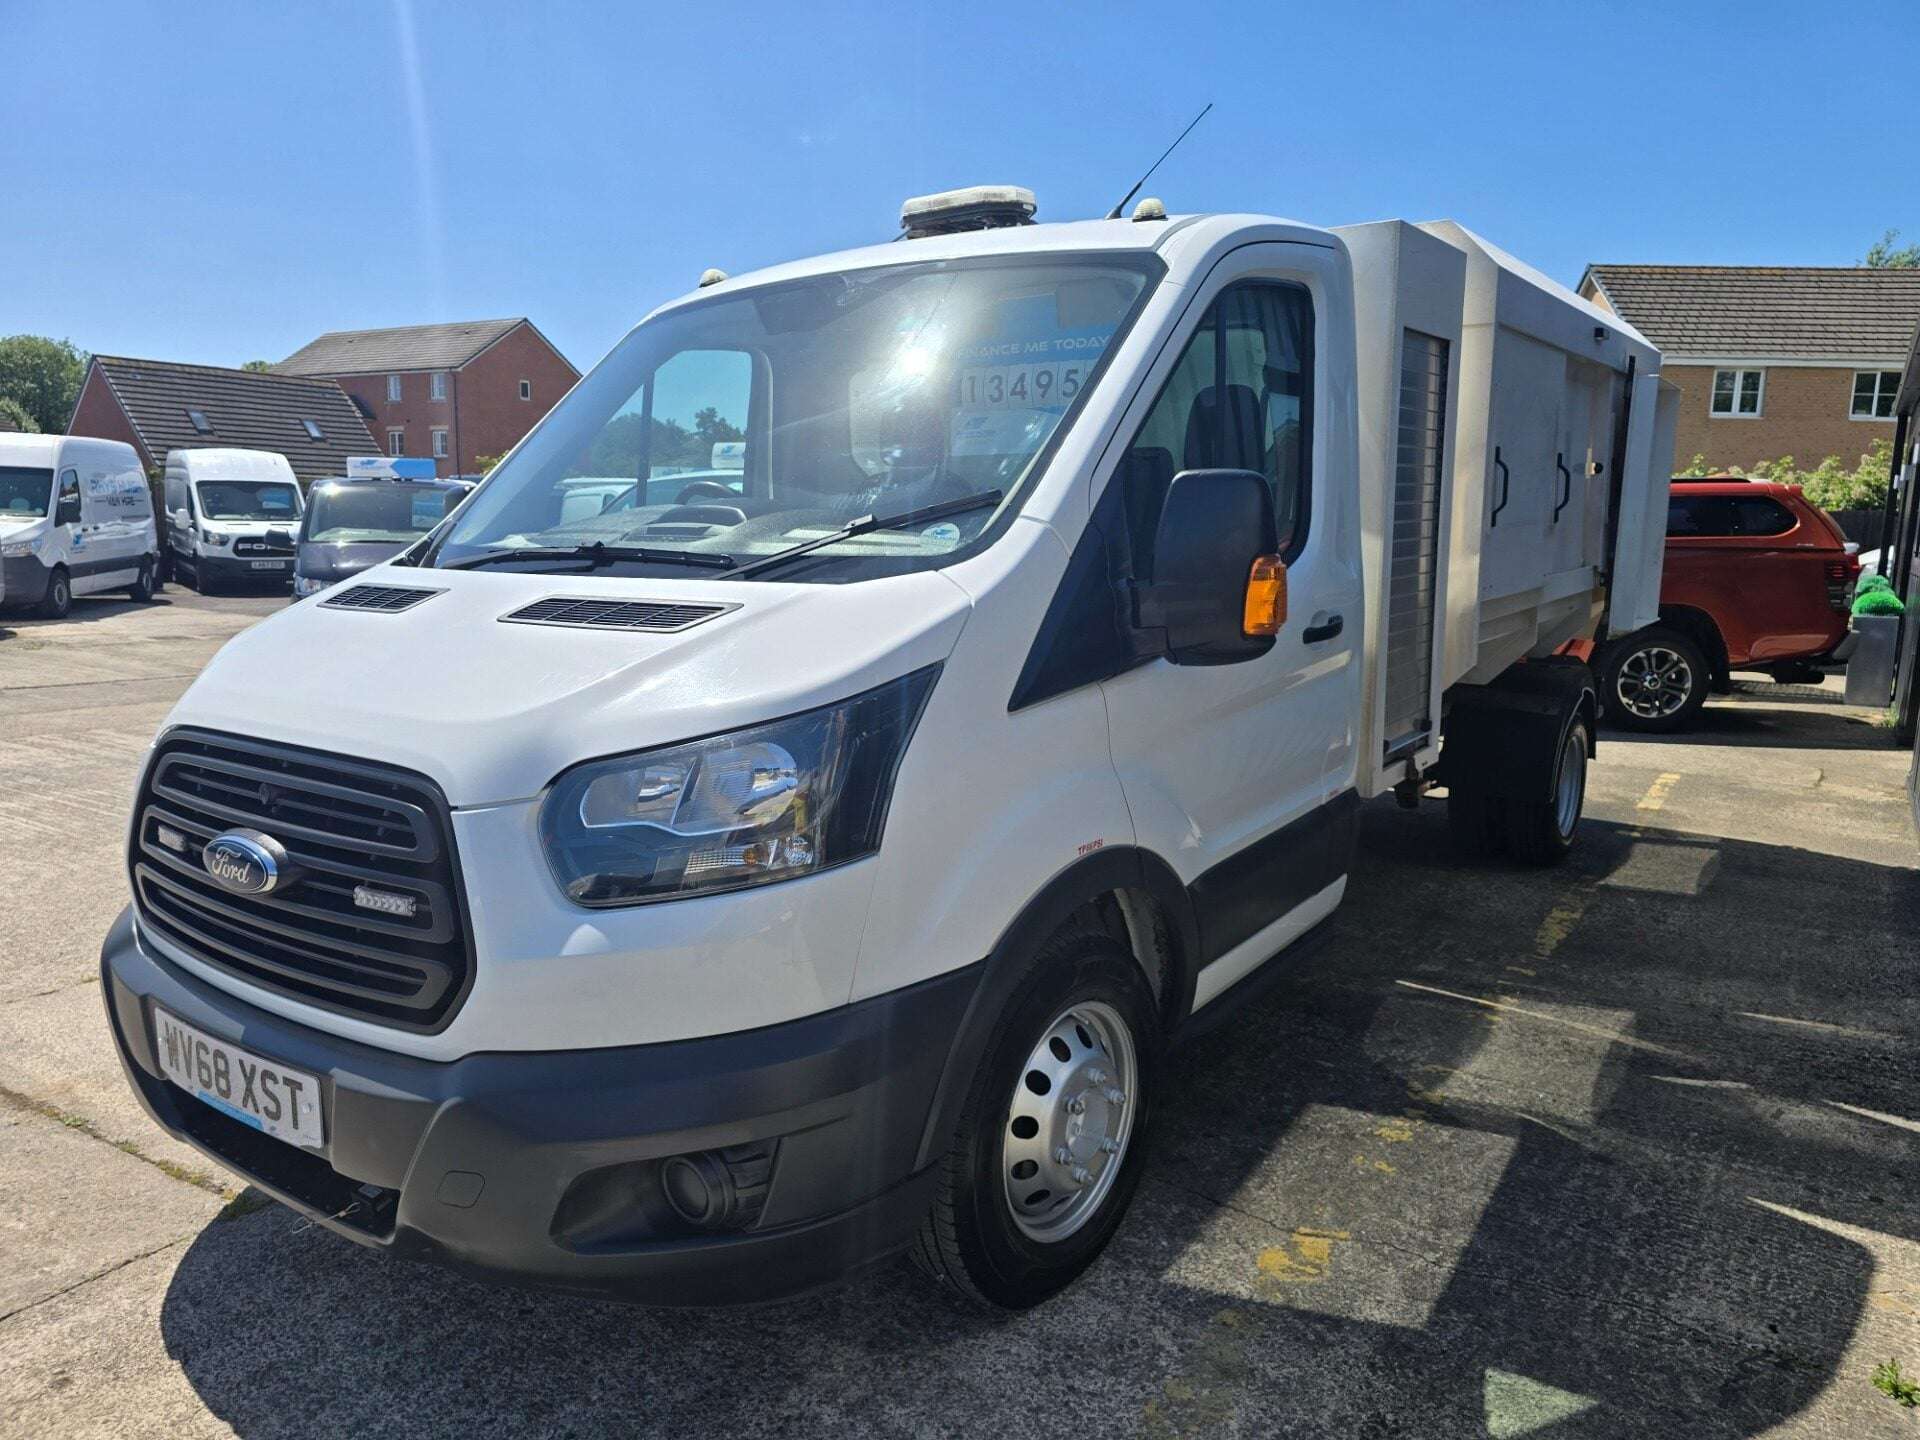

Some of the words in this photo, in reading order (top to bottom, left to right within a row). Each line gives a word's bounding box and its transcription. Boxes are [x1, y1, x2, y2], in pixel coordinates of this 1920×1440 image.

[1024, 341, 1049, 352] ME
[1054, 335, 1111, 350] TODAY
[211, 846, 251, 884] Ford
[164, 1021, 232, 1100] WV68
[238, 1058, 304, 1130] XST
